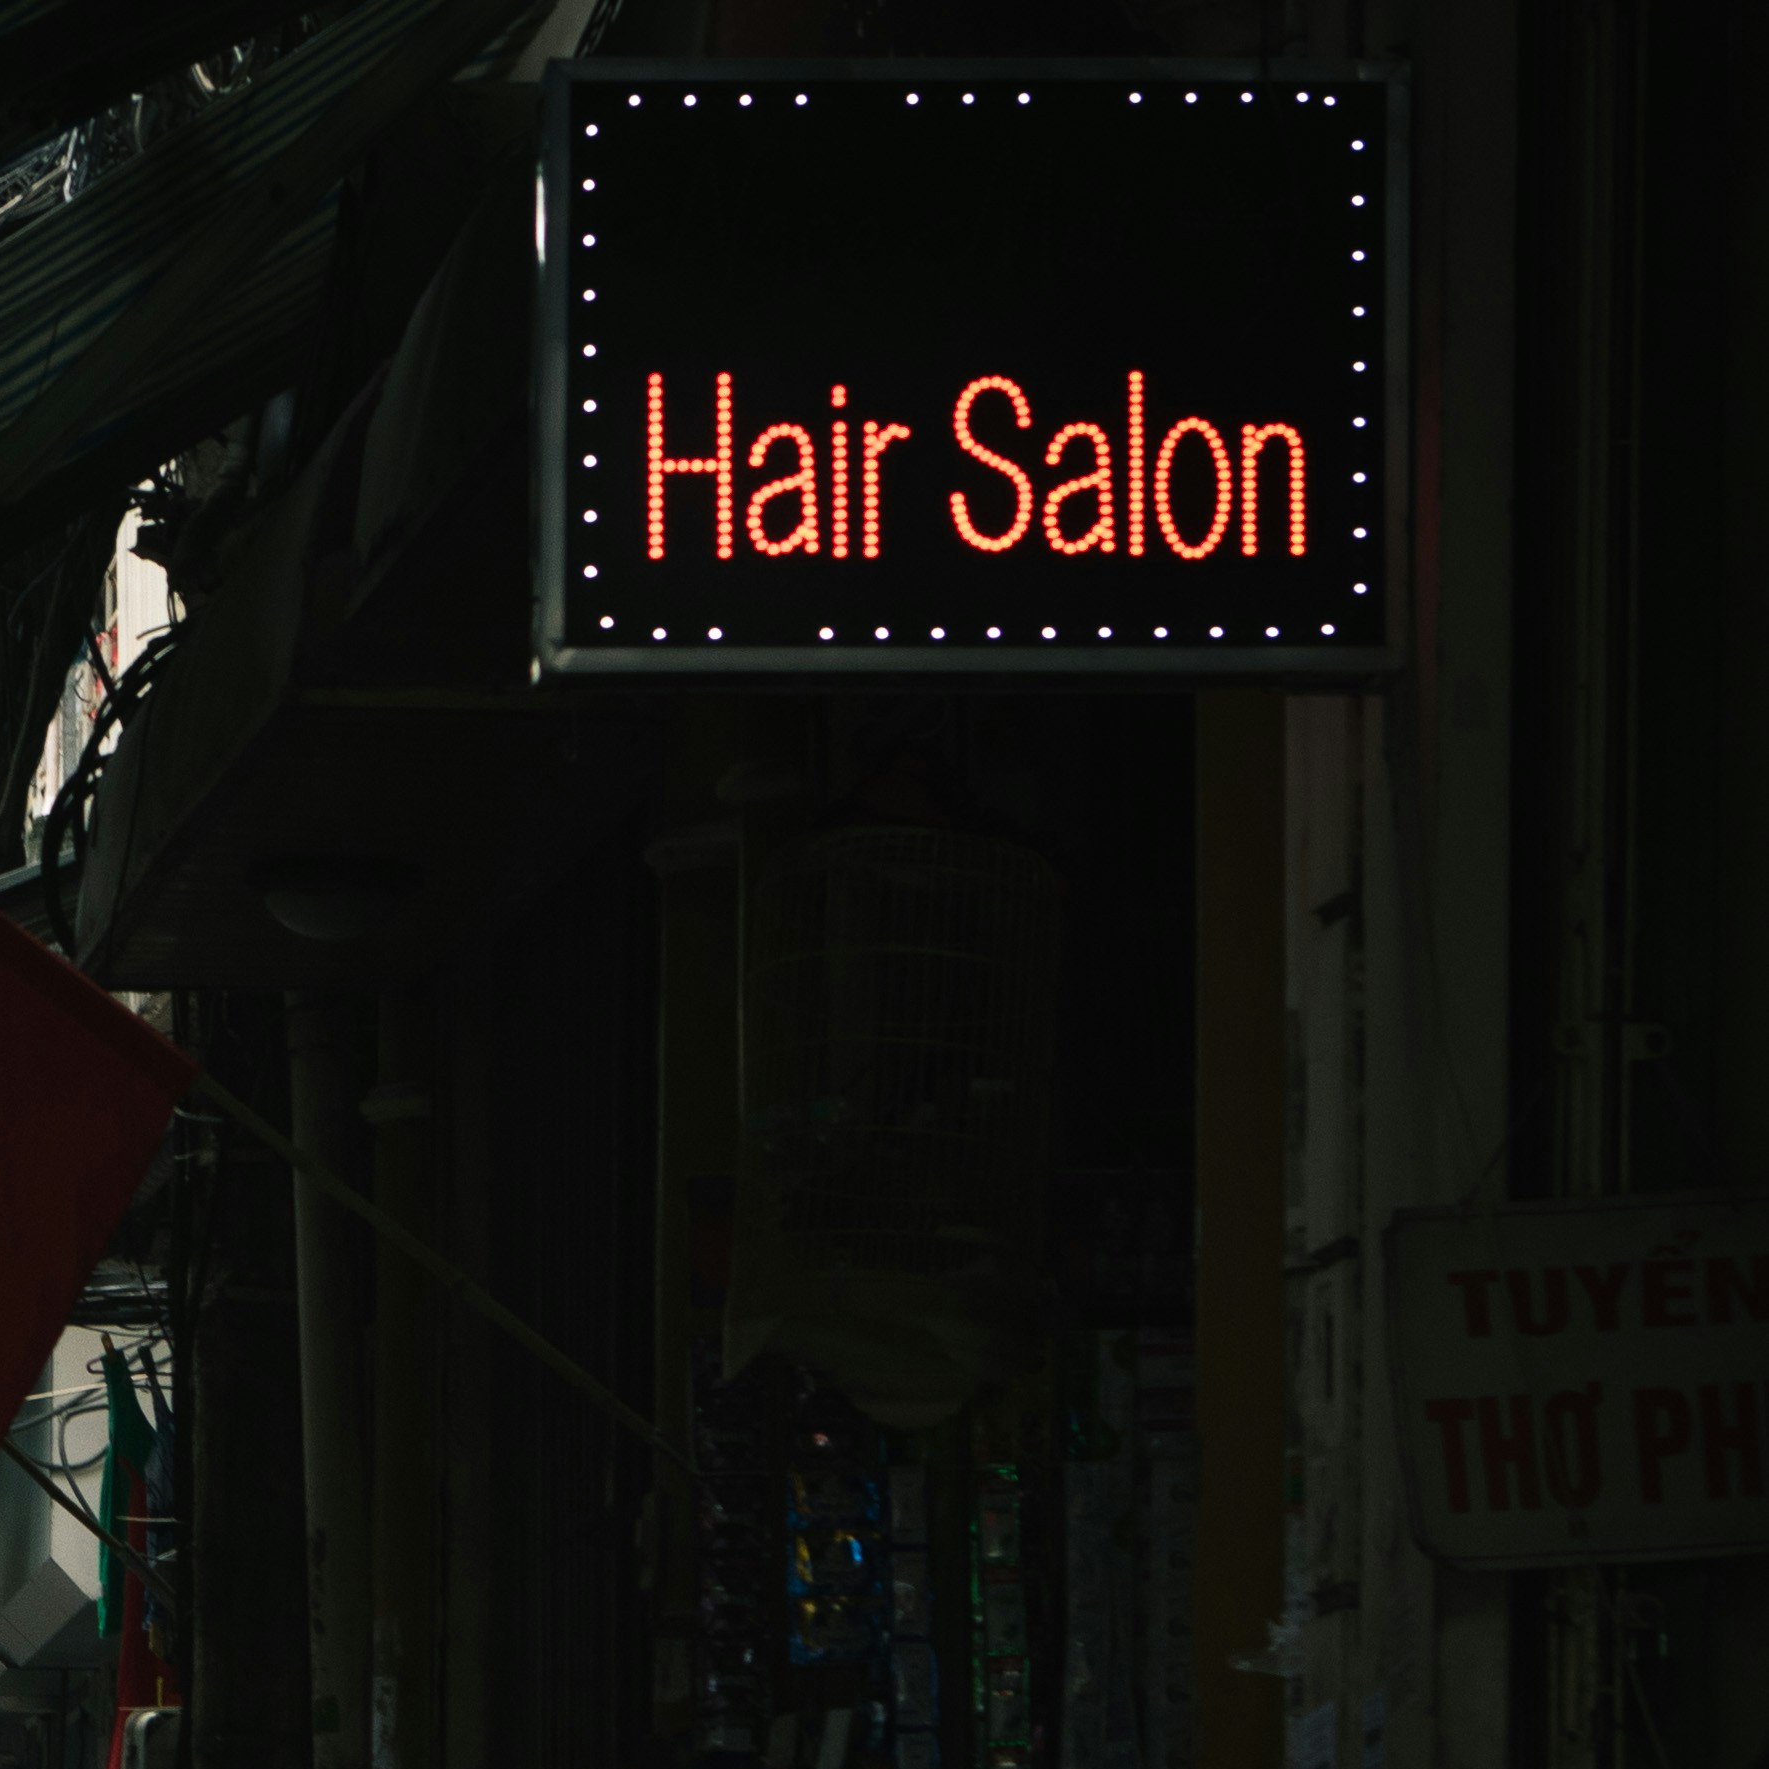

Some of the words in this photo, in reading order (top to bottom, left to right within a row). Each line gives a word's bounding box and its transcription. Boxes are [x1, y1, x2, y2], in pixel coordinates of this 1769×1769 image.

[648, 372, 911, 558] Hair
[950, 371, 1305, 558] Salon
[1630, 1381, 1769, 1505] PH
